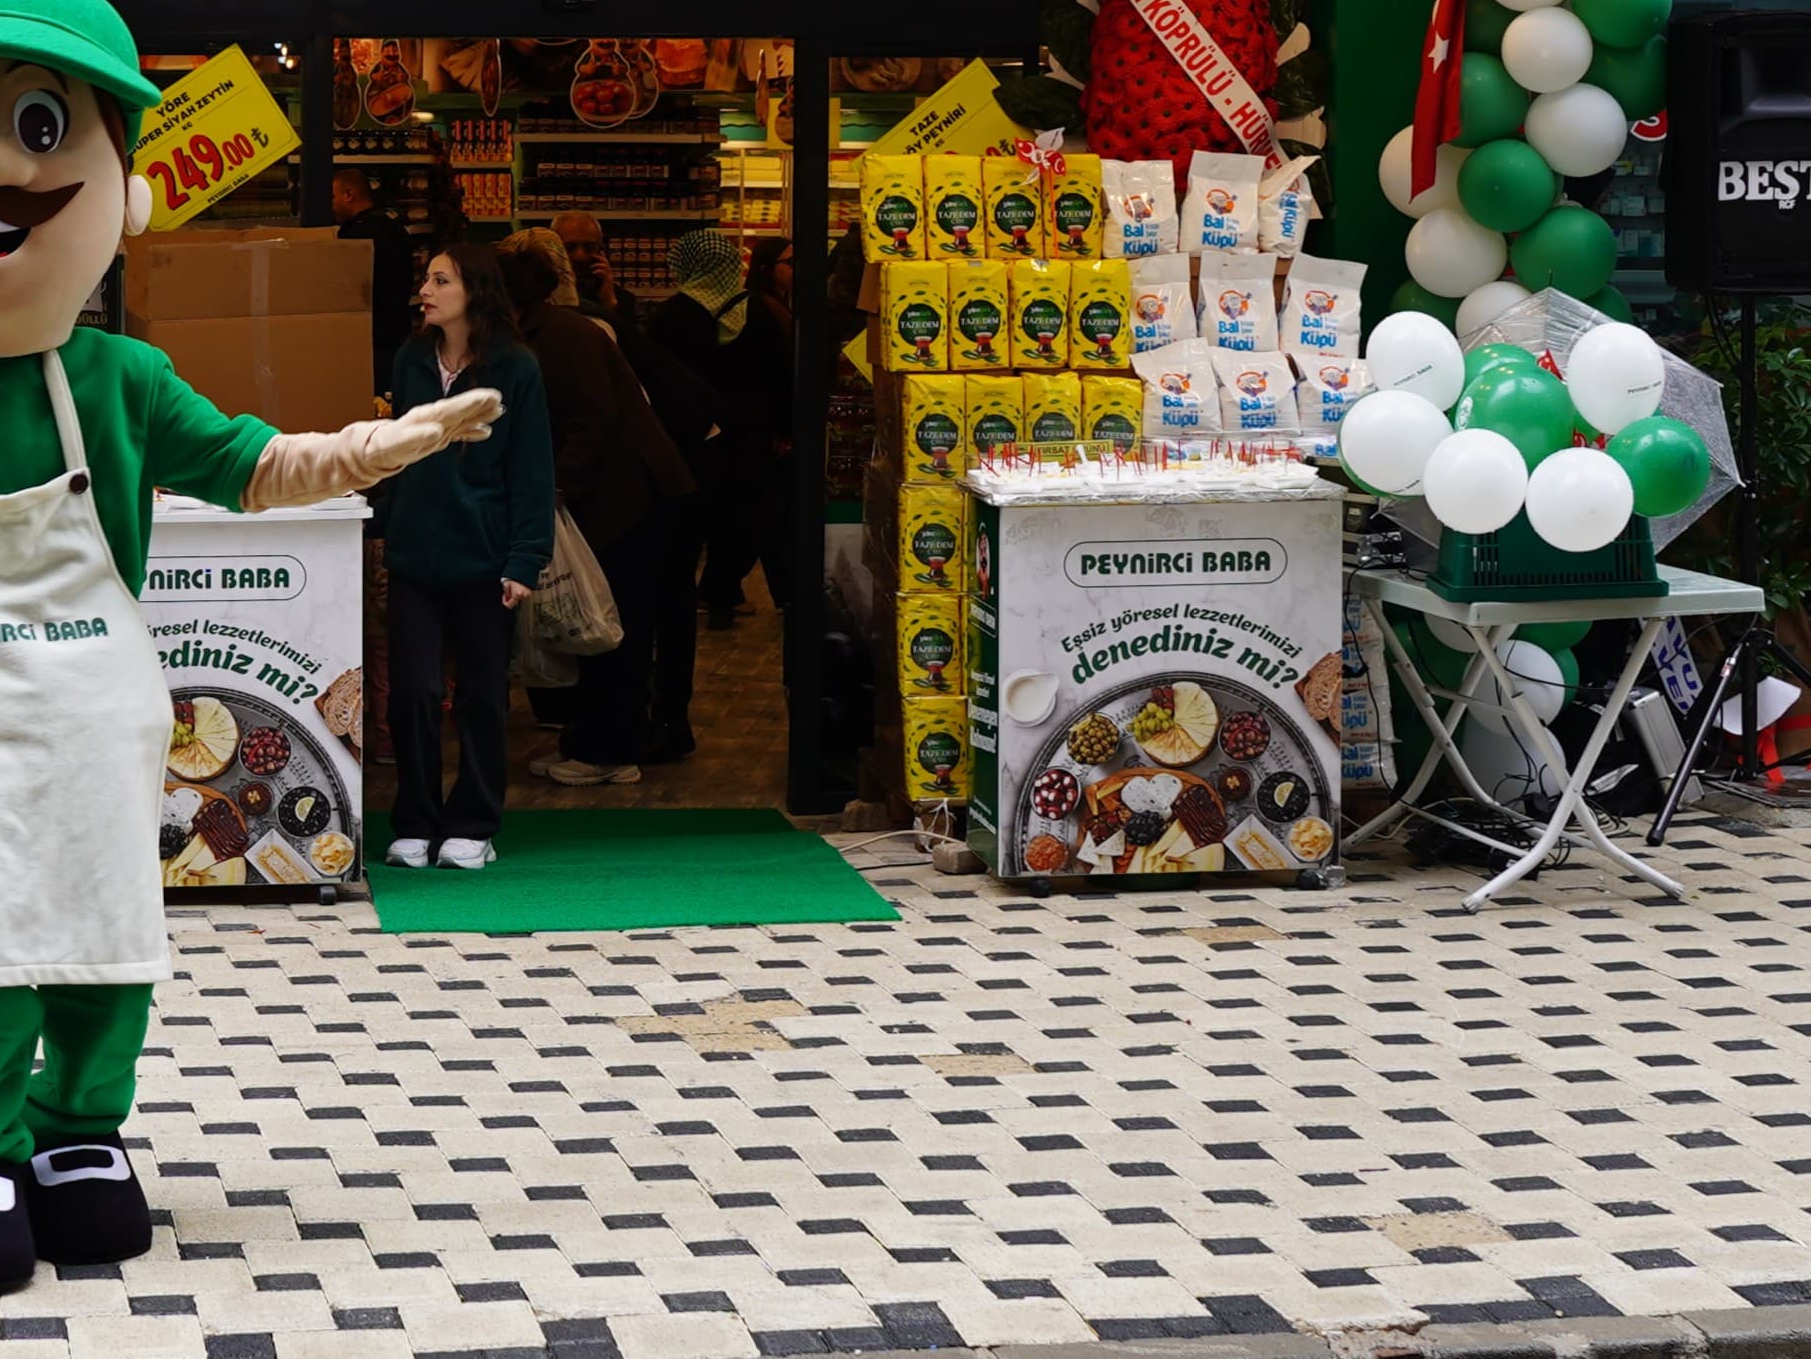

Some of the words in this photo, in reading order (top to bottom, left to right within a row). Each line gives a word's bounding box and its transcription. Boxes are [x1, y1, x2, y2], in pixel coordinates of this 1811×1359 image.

[156, 91, 191, 118] YÖRE
[162, 104, 197, 131] SİYAH
[195, 79, 235, 110] ZEYTİN
[909, 110, 940, 137] TAZE
[1203, 213, 1225, 229] Bal
[1123, 223, 1144, 238] Bal
[1123, 239, 1158, 255] Küpü
[1202, 231, 1238, 249] Küpü
[1218, 320, 1239, 333] Bal
[1302, 314, 1323, 328] Bal
[1135, 324, 1157, 338] Bal
[1301, 331, 1337, 349] Küpü
[1240, 397, 1262, 411] Bal
[1322, 391, 1344, 404] Bal
[1162, 410, 1199, 428] Küpü
[1202, 550, 1271, 573] BABA
[221, 567, 290, 589] BABA
[44, 617, 108, 642] BABA
[1060, 622, 1107, 653] Eşsiz
[1110, 603, 1179, 633] yöresel
[1184, 603, 1303, 658] lezzetlerimizi
[147, 619, 198, 639] resel
[203, 619, 323, 675] lezzetlerimizi
[1072, 624, 1235, 685] denediniz
[1236, 646, 1299, 689] mi?
[158, 639, 255, 675] ediniz
[256, 663, 319, 705] mi?
[1341, 712, 1368, 730] üpü
